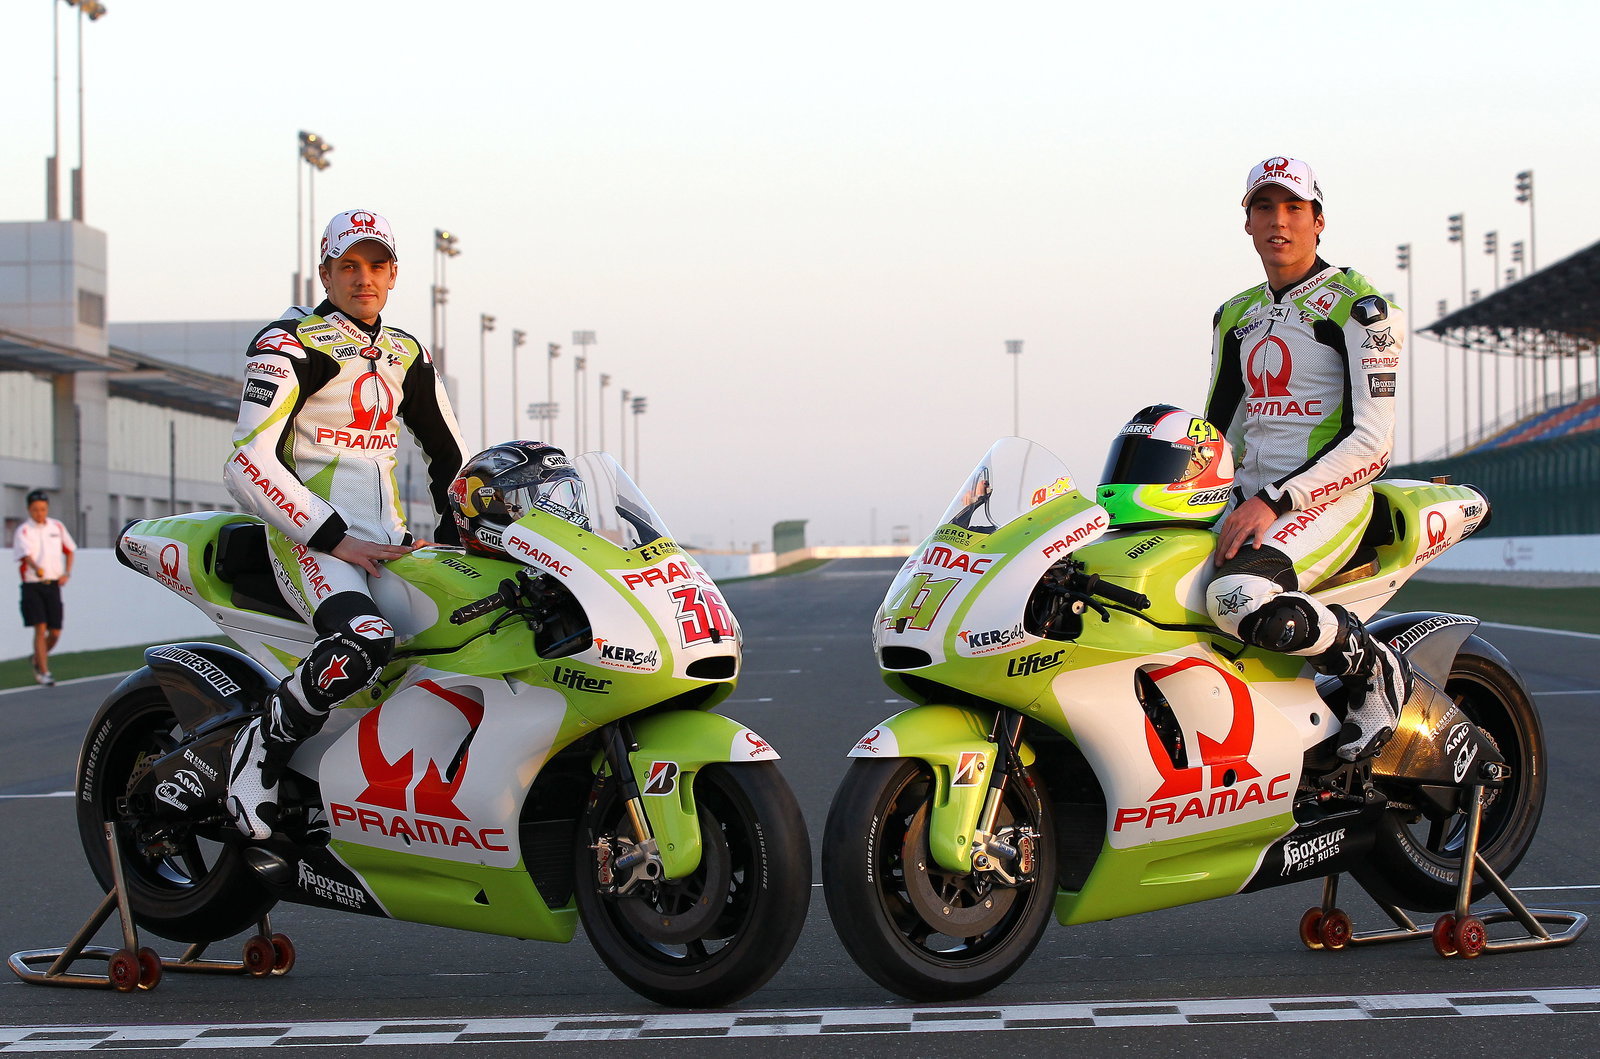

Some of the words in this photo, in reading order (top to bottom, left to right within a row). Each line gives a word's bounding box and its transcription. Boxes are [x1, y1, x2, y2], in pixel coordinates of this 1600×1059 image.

[338, 227, 389, 242] PRAMAC
[1289, 273, 1328, 299] PRAMAC
[331, 315, 369, 344] PRAMAC
[316, 427, 398, 449] PRAMAC
[1120, 425, 1156, 434] HARK
[1187, 418, 1220, 444] 41
[233, 451, 312, 528] PRAMAC
[1310, 452, 1389, 502] PRAMAC
[480, 531, 502, 546] SHOE
[1042, 516, 1106, 558] PRAMAC
[1127, 535, 1164, 559] DUCATI
[1415, 537, 1452, 564] PRAMAC
[284, 536, 334, 600] RAMAC
[441, 558, 482, 579] DUCATI
[508, 536, 572, 577] PRAMAC
[155, 571, 193, 595] PRAMAC
[669, 585, 735, 648] 36
[150, 644, 242, 697] BRIDGESTONE
[1007, 649, 1066, 677] Lifter
[553, 666, 612, 694] Lifter
[83, 718, 113, 803] BRIDGESTONE
[194, 756, 218, 776] ENERGY
[1113, 773, 1290, 832] PRAMAC
[330, 802, 510, 852] PRAMAC
[754, 822, 768, 890] BRIDGESTONE
[866, 815, 879, 883] BRIDGESTONE
[1290, 828, 1346, 865] BOXEUR
[1297, 857, 1315, 871] DES
[1317, 844, 1340, 862] RUES
[306, 870, 367, 903] BOXEUR
[315, 886, 333, 900] DES
[336, 895, 361, 909] RUES
